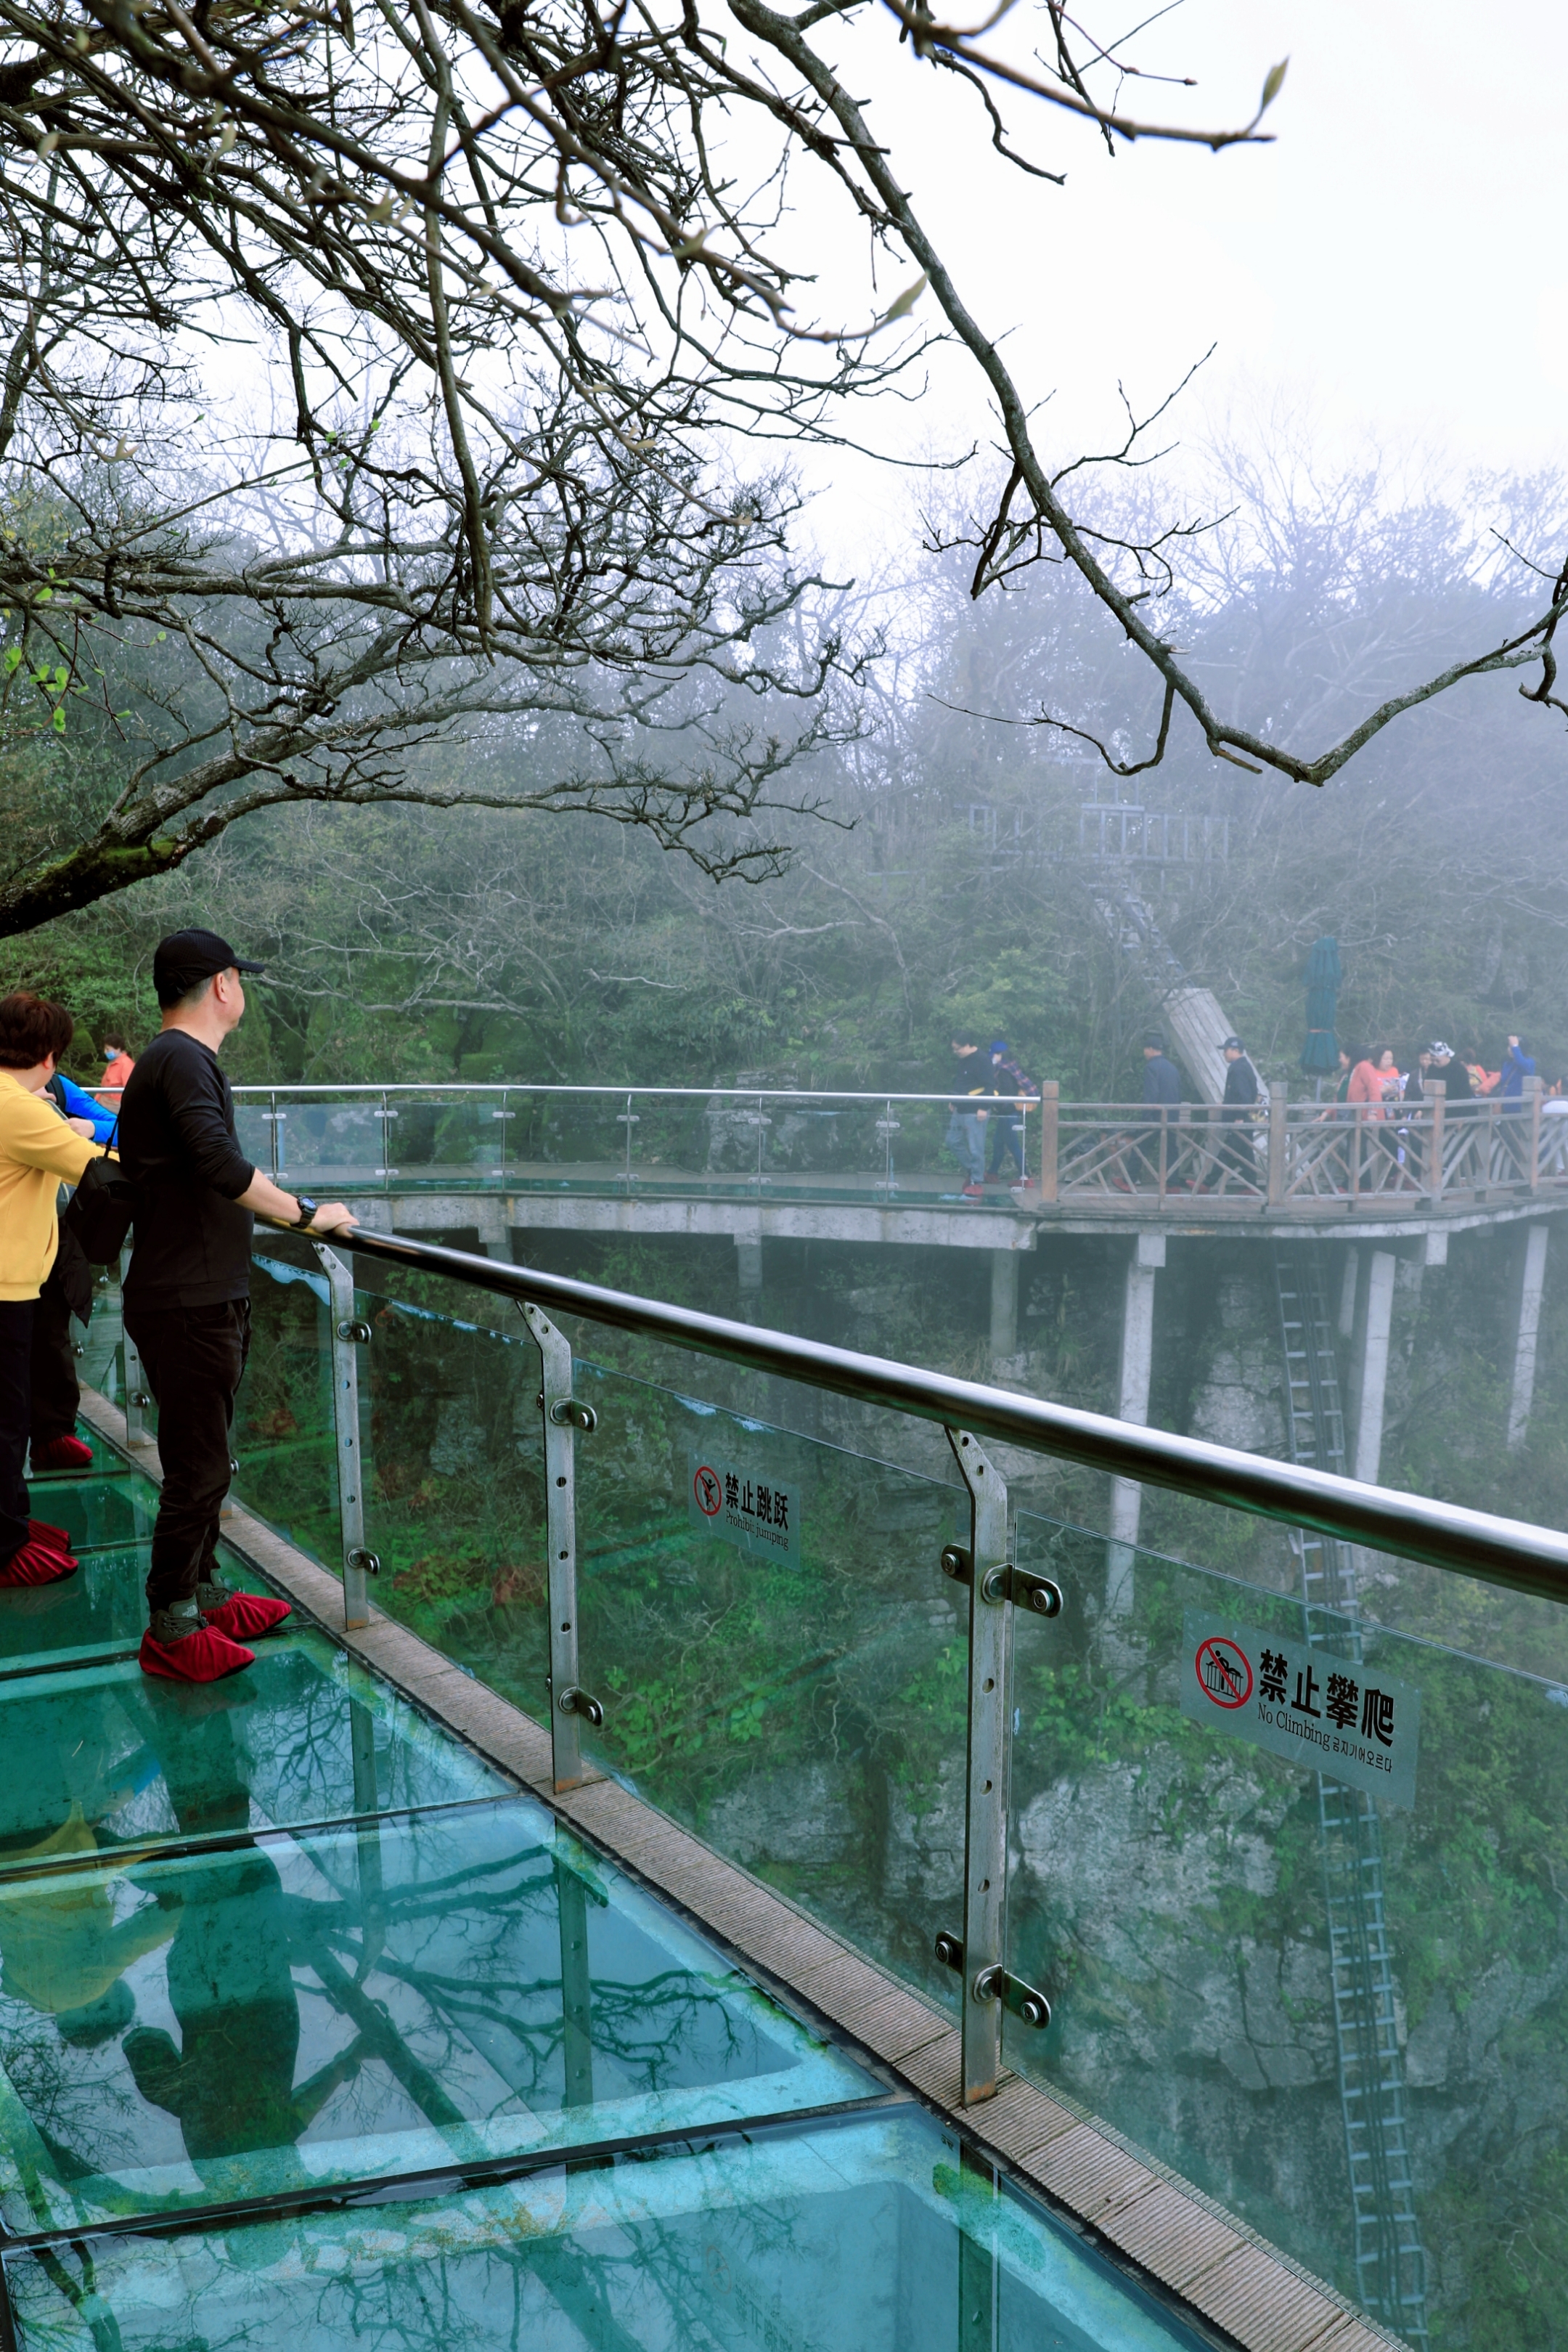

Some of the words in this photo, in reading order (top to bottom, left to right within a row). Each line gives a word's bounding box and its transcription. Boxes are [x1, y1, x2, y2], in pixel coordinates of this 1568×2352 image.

[725, 1473, 789, 1530] 禁止跳跃
[726, 1510, 754, 1533] Prohibit
[756, 1523, 789, 1551] jumping
[1259, 1648, 1395, 1748] 禁止攀爬
[1257, 1702, 1273, 1724] No
[1275, 1711, 1331, 1751] Climbing
[1333, 1737, 1392, 1773] 금지기어오르다
